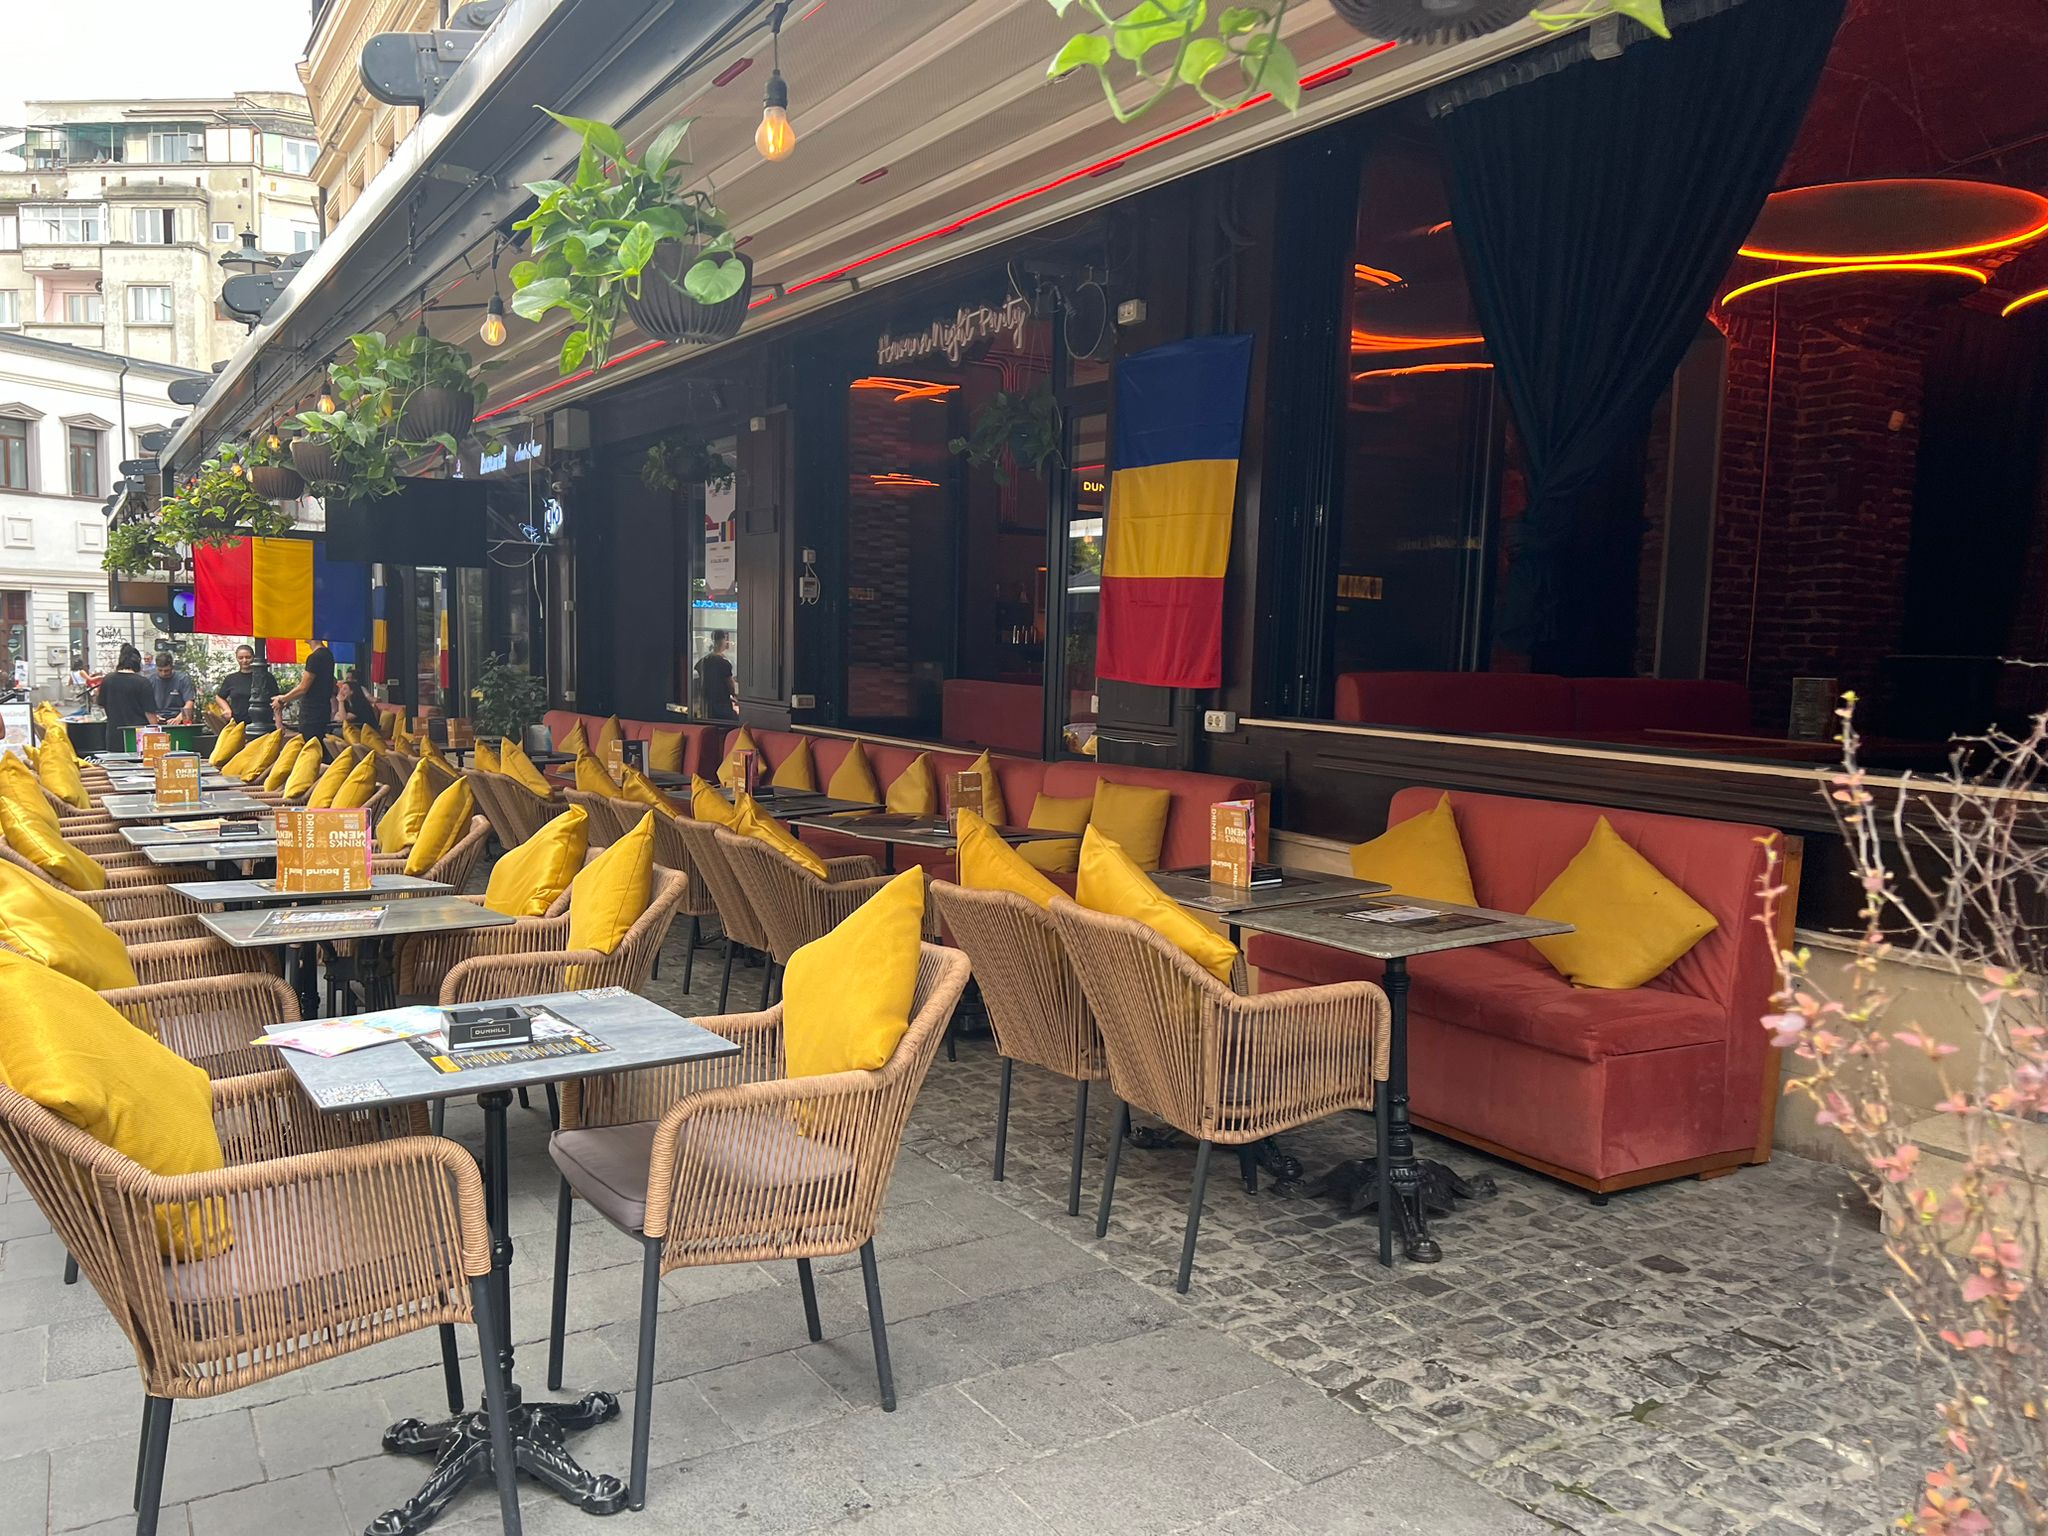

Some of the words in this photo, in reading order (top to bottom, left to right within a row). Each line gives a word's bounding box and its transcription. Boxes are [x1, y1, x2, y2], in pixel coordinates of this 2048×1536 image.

[979, 295, 1025, 348] Party
[305, 814, 314, 848] DRINKS
[329, 831, 366, 839] MENU
[306, 868, 339, 876] bound
[474, 1027, 506, 1036] DUNHILL
